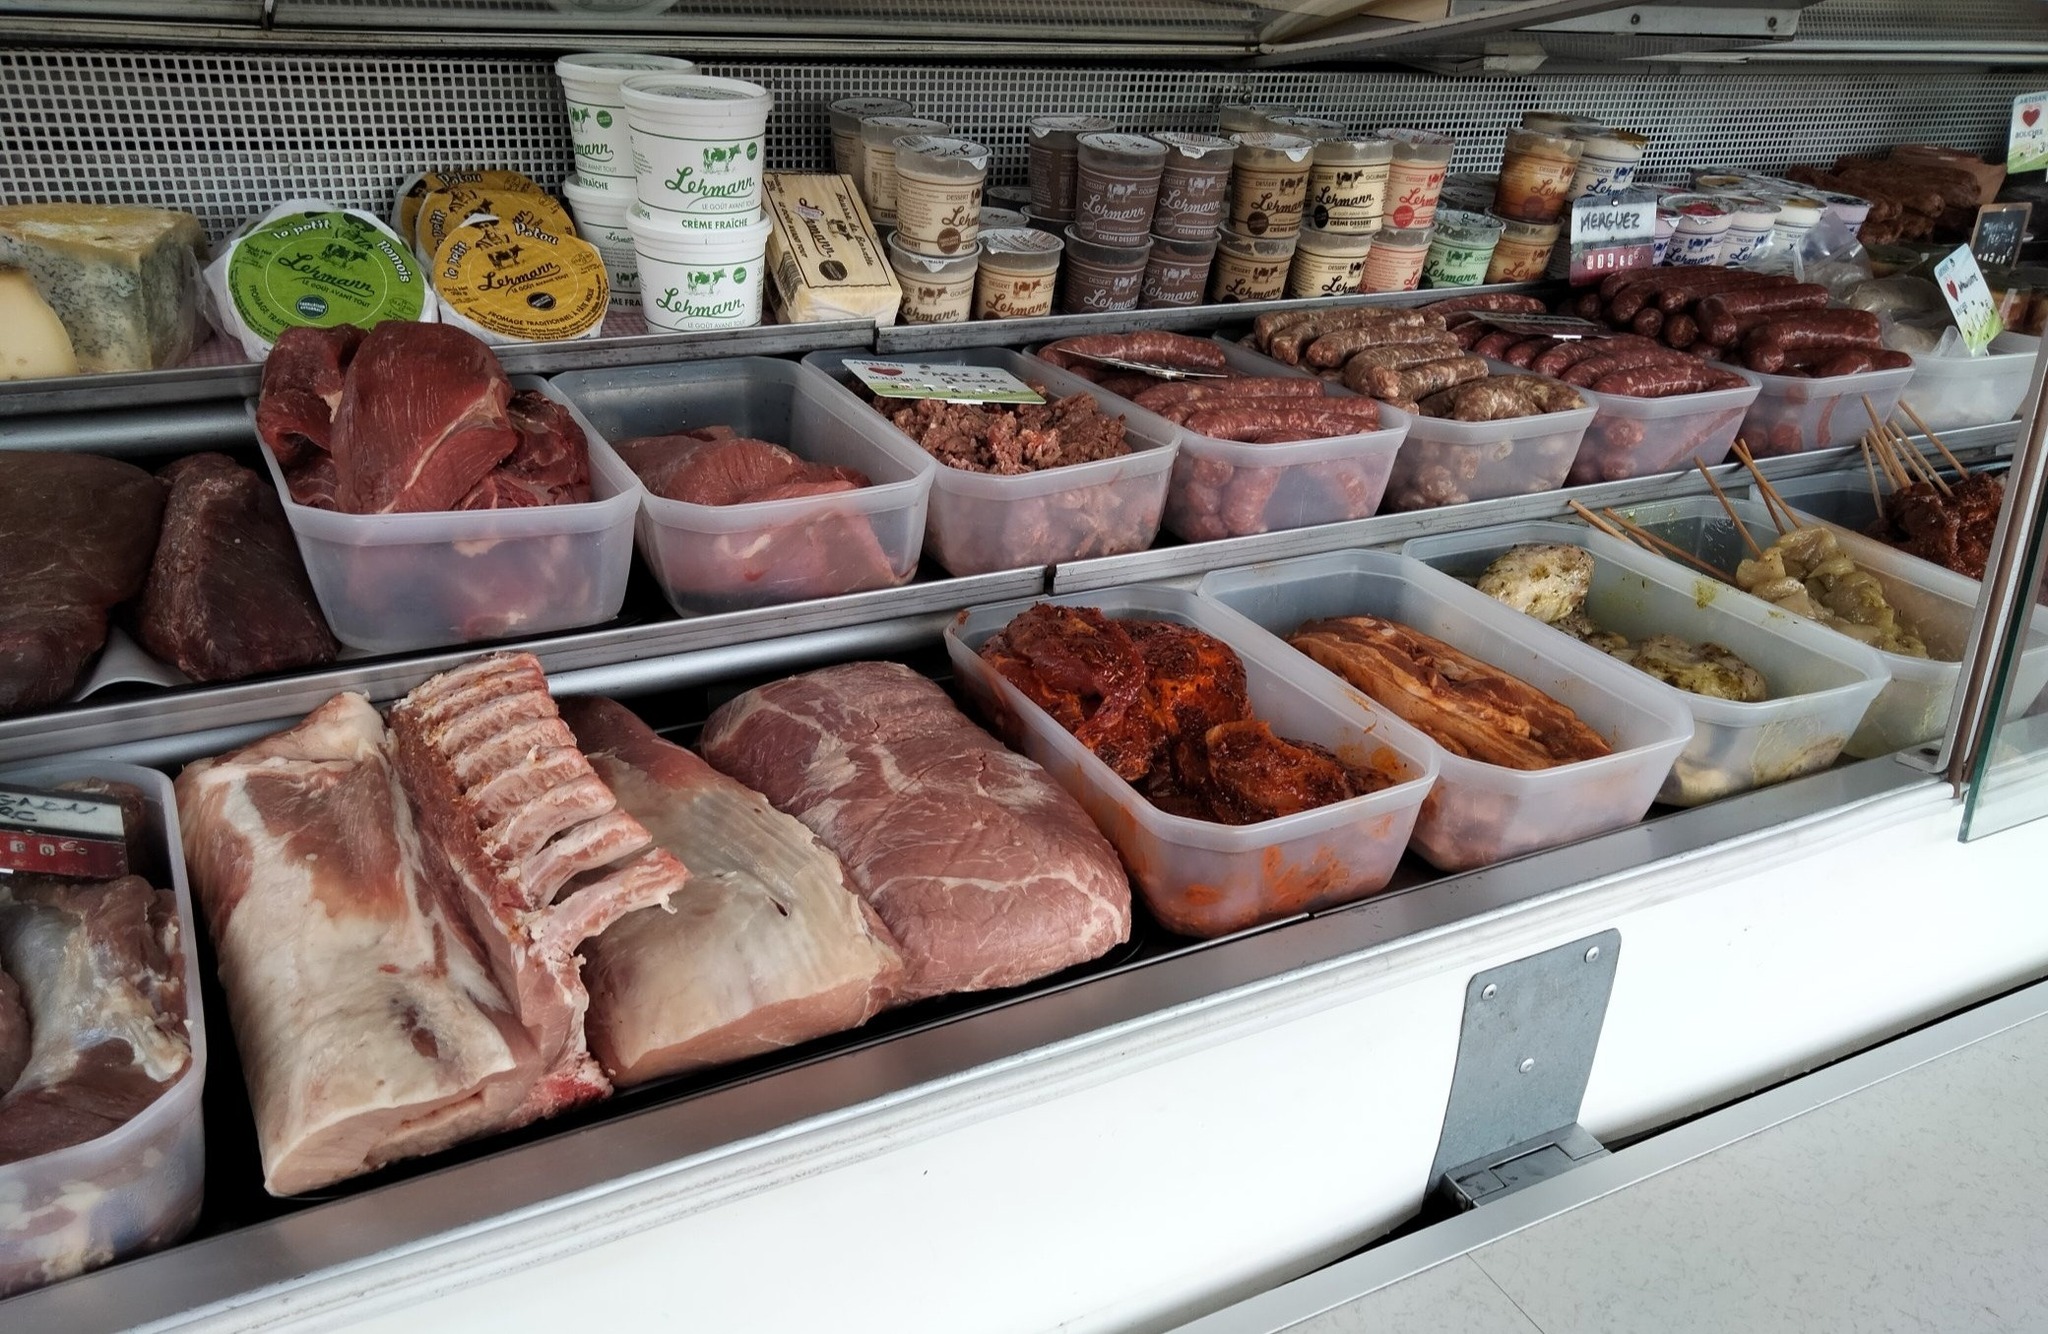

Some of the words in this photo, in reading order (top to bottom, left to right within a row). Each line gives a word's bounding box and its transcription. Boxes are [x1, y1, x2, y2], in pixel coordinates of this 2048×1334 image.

[664, 166, 755, 198] Lehmann
[1255, 180, 1278, 188] DESSERT
[1082, 194, 1146, 219] Lehmann
[1159, 189, 1221, 214] Lehmann
[1314, 185, 1375, 207] Lehmann
[681, 218, 714, 230] CRÈME
[714, 217, 748, 230] FRAÎCHE
[1329, 219, 1348, 227] CRÈME
[1349, 219, 1372, 227] DESSERT
[1580, 210, 1640, 233] MERGUEZ
[1098, 233, 1118, 242] CRÈME
[1118, 235, 1141, 243] DESSERT
[278, 252, 375, 297] Lehmann
[478, 261, 562, 292] Lehmann
[1422, 260, 1478, 283] Lehmann
[248, 284, 270, 315] FROMAGE
[311, 281, 330, 294] GOÛT
[330, 287, 351, 302] AVANT
[352, 297, 371, 308] TOUT
[1141, 277, 1199, 300] Lehmann
[1225, 278, 1282, 299] Lehmann
[655, 287, 745, 317] Lehmann
[985, 292, 1049, 316] Lehmann
[487, 310, 524, 326] FROMAGE
[525, 314, 573, 326] TRADITIONNEL
